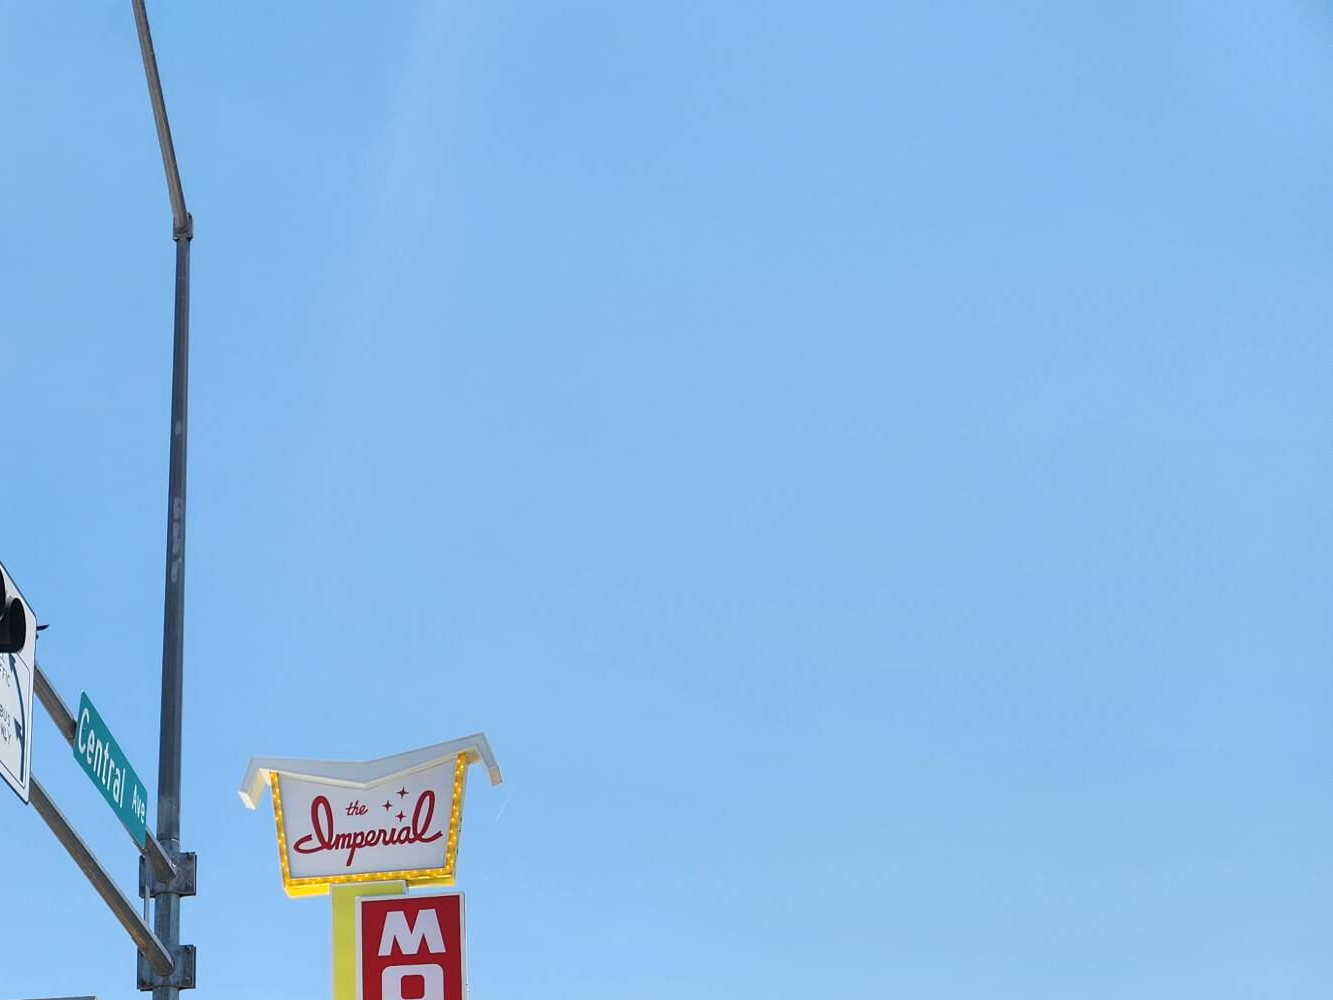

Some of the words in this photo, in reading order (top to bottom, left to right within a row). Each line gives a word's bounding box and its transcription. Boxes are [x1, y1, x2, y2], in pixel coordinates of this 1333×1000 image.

[0, 704, 11, 727] BUS
[78, 707, 126, 809] Central
[131, 784, 146, 824] Ave
[293, 790, 444, 867] Imperial
[345, 800, 369, 816] the
